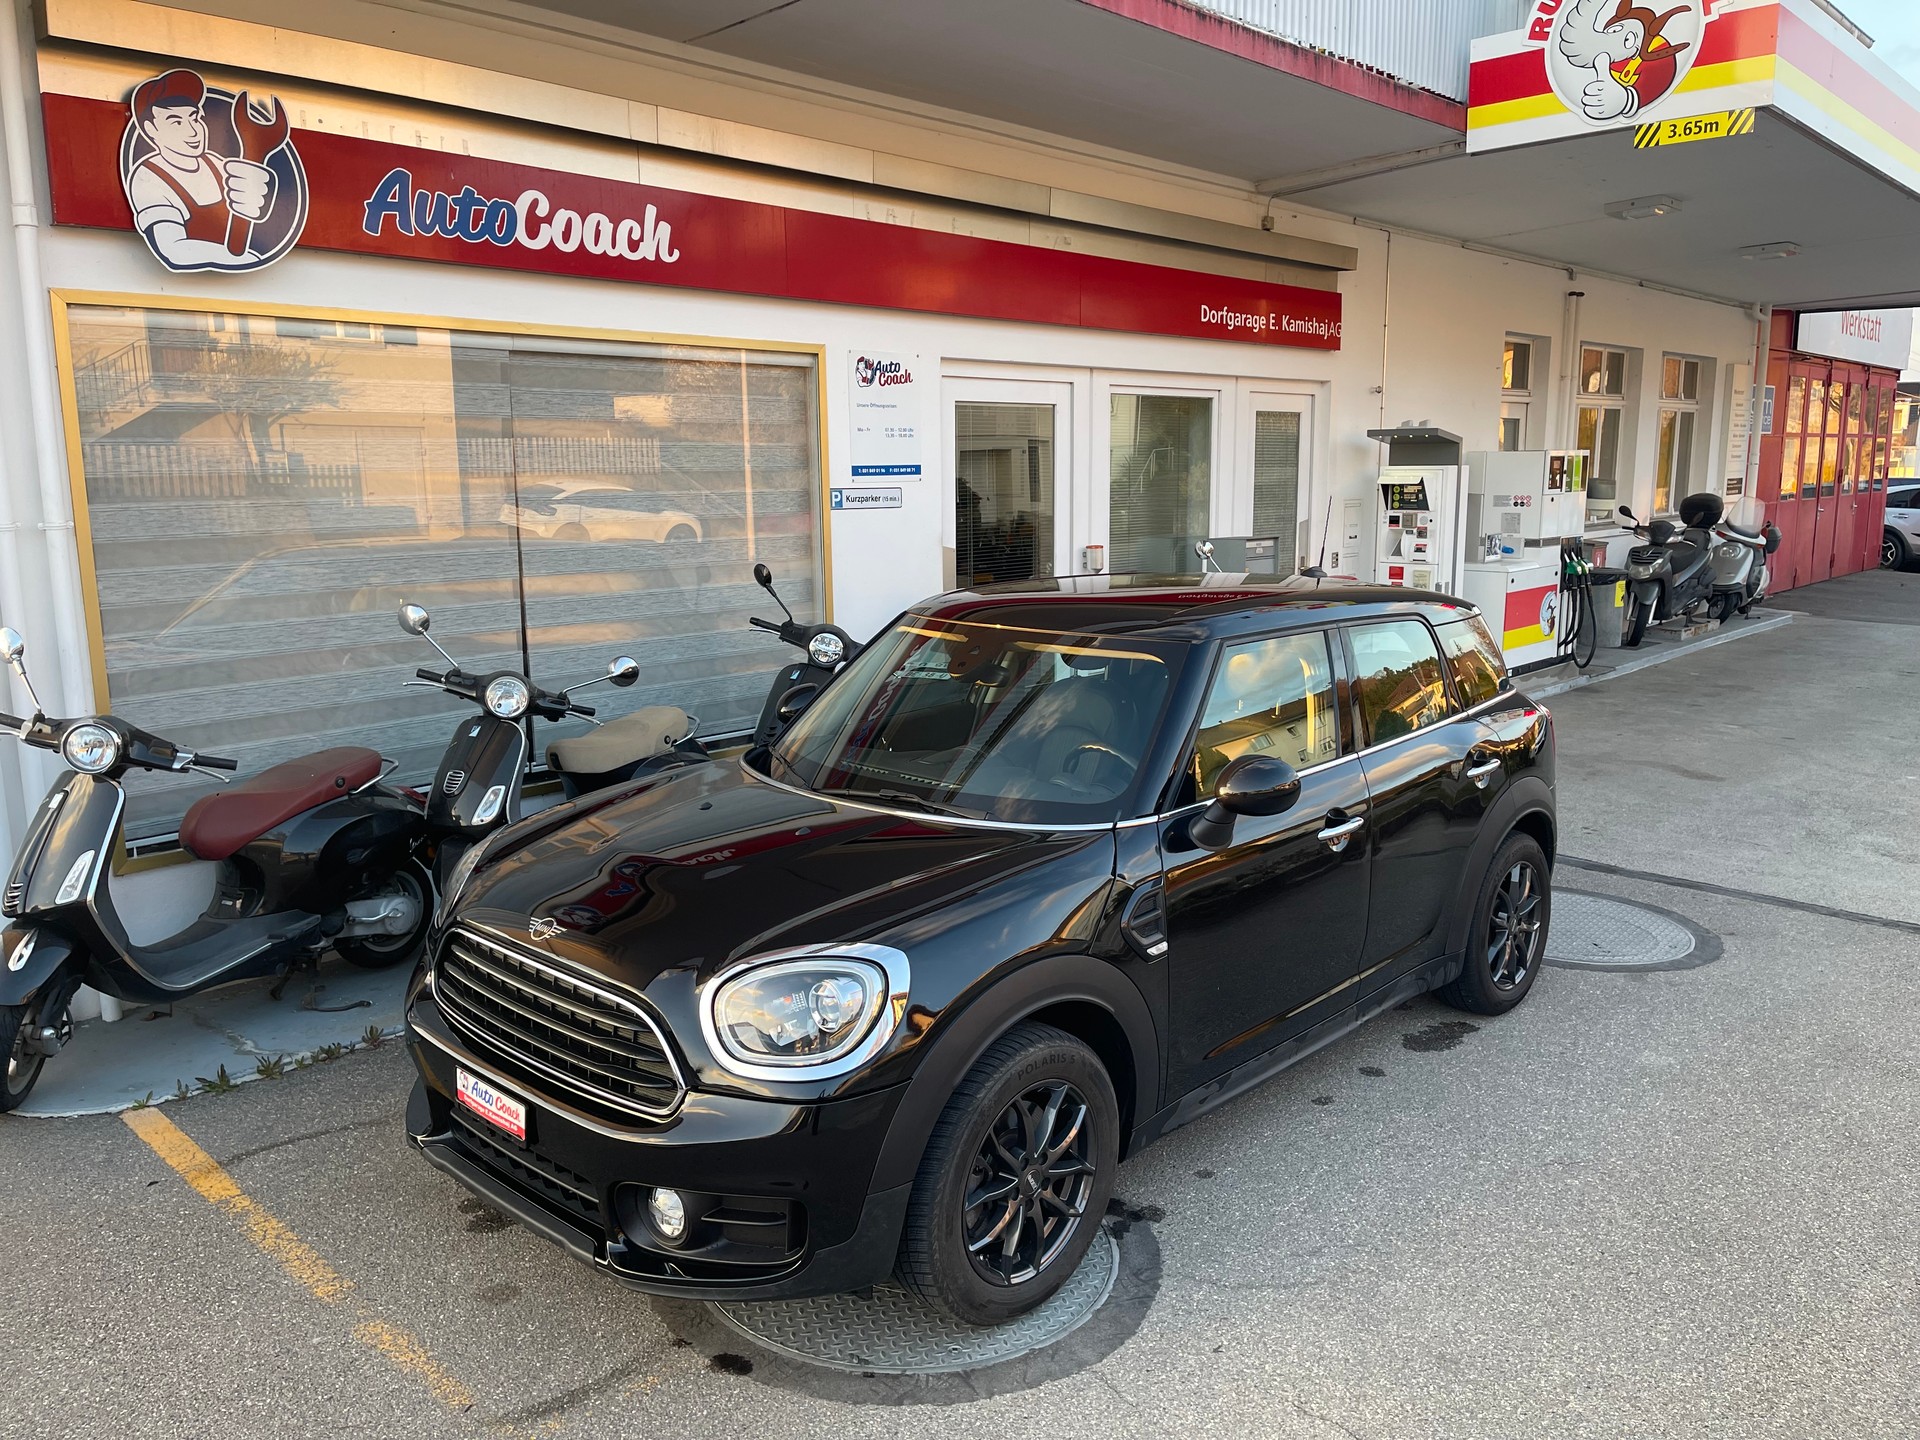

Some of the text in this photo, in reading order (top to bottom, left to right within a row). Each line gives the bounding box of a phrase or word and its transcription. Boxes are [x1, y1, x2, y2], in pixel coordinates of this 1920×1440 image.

[1668, 120, 1719, 138] 3.65m
[1201, 304, 1266, 333] Dorfgarage
[1269, 313, 1279, 330] E.
[1841, 311, 1882, 343] Werkstatt
[874, 360, 901, 376] Auto
[878, 369, 914, 387] Coach
[845, 494, 881, 504] Kurzparker
[1017, 1053, 1067, 1081] POLARIS
[471, 1080, 521, 1123] Auto Coach
